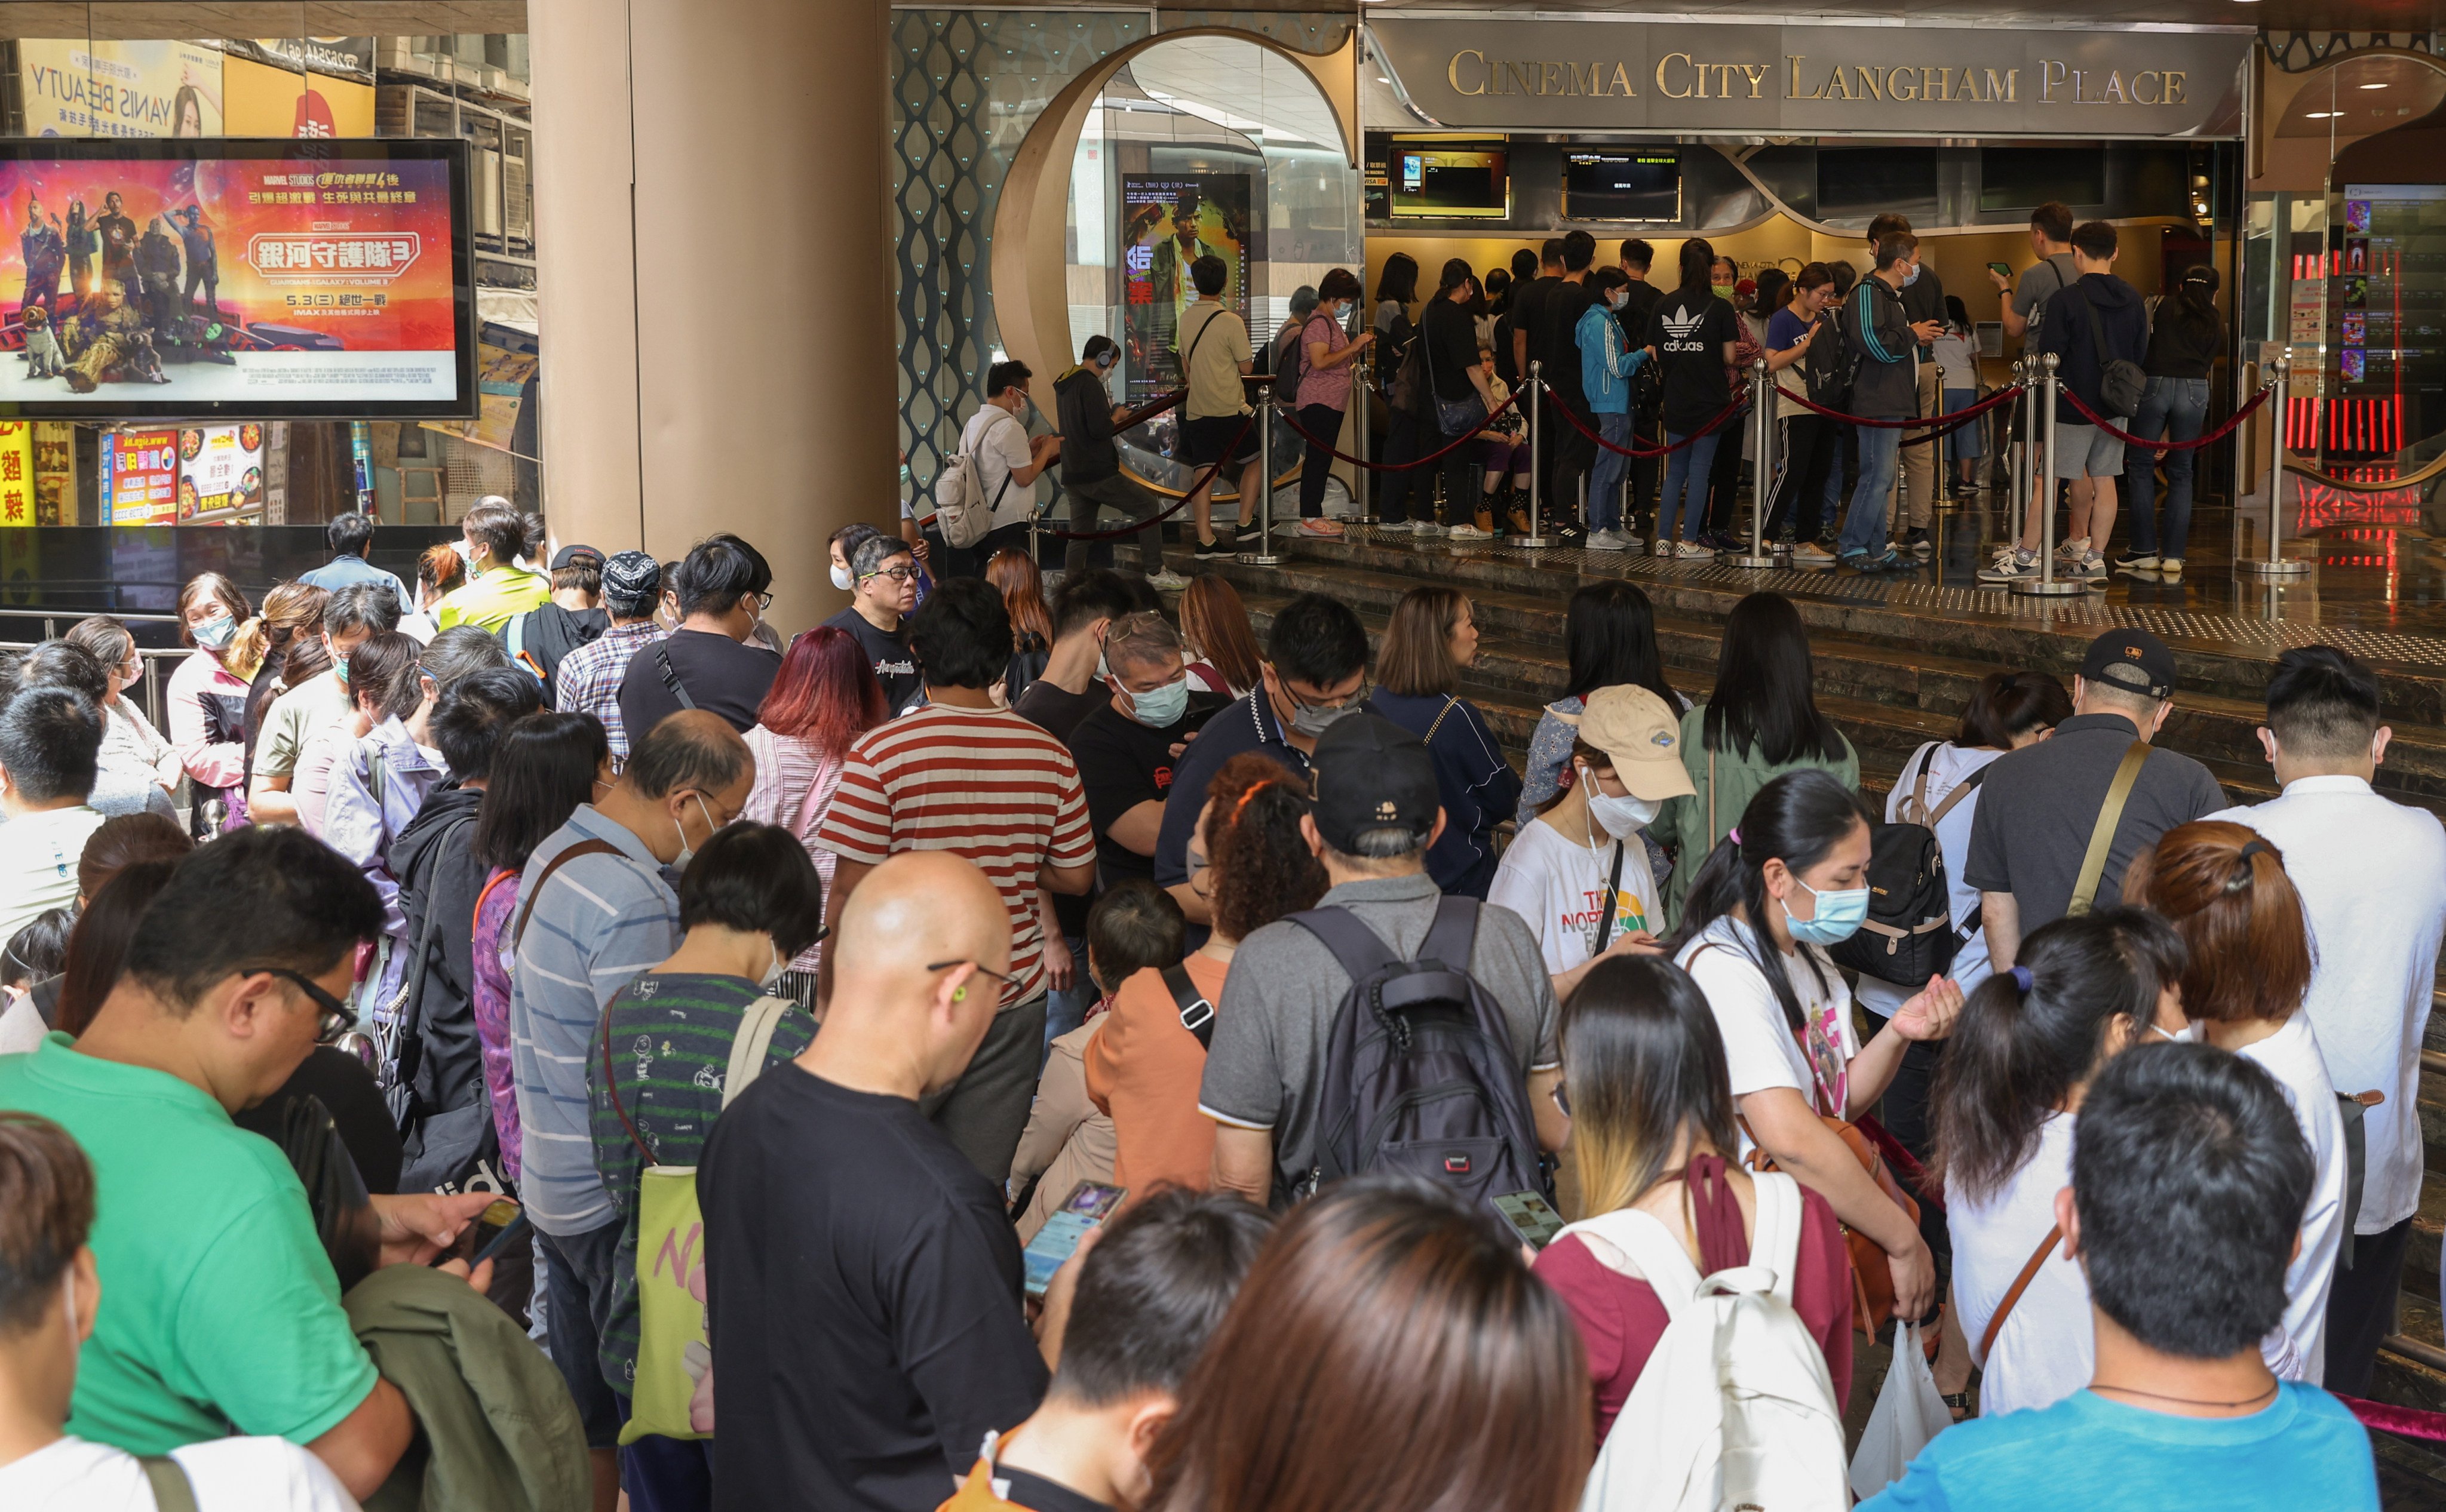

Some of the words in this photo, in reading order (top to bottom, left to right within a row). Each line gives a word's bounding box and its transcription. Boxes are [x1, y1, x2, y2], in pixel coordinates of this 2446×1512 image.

[1448, 50, 1637, 96] CINEMA
[1656, 53, 1770, 99] CITY
[1785, 55, 2020, 102] LANGHAM
[2038, 59, 2187, 105] PLACE
[263, 175, 288, 185] MARVEL
[258, 241, 410, 268] 銀河守護隊3
